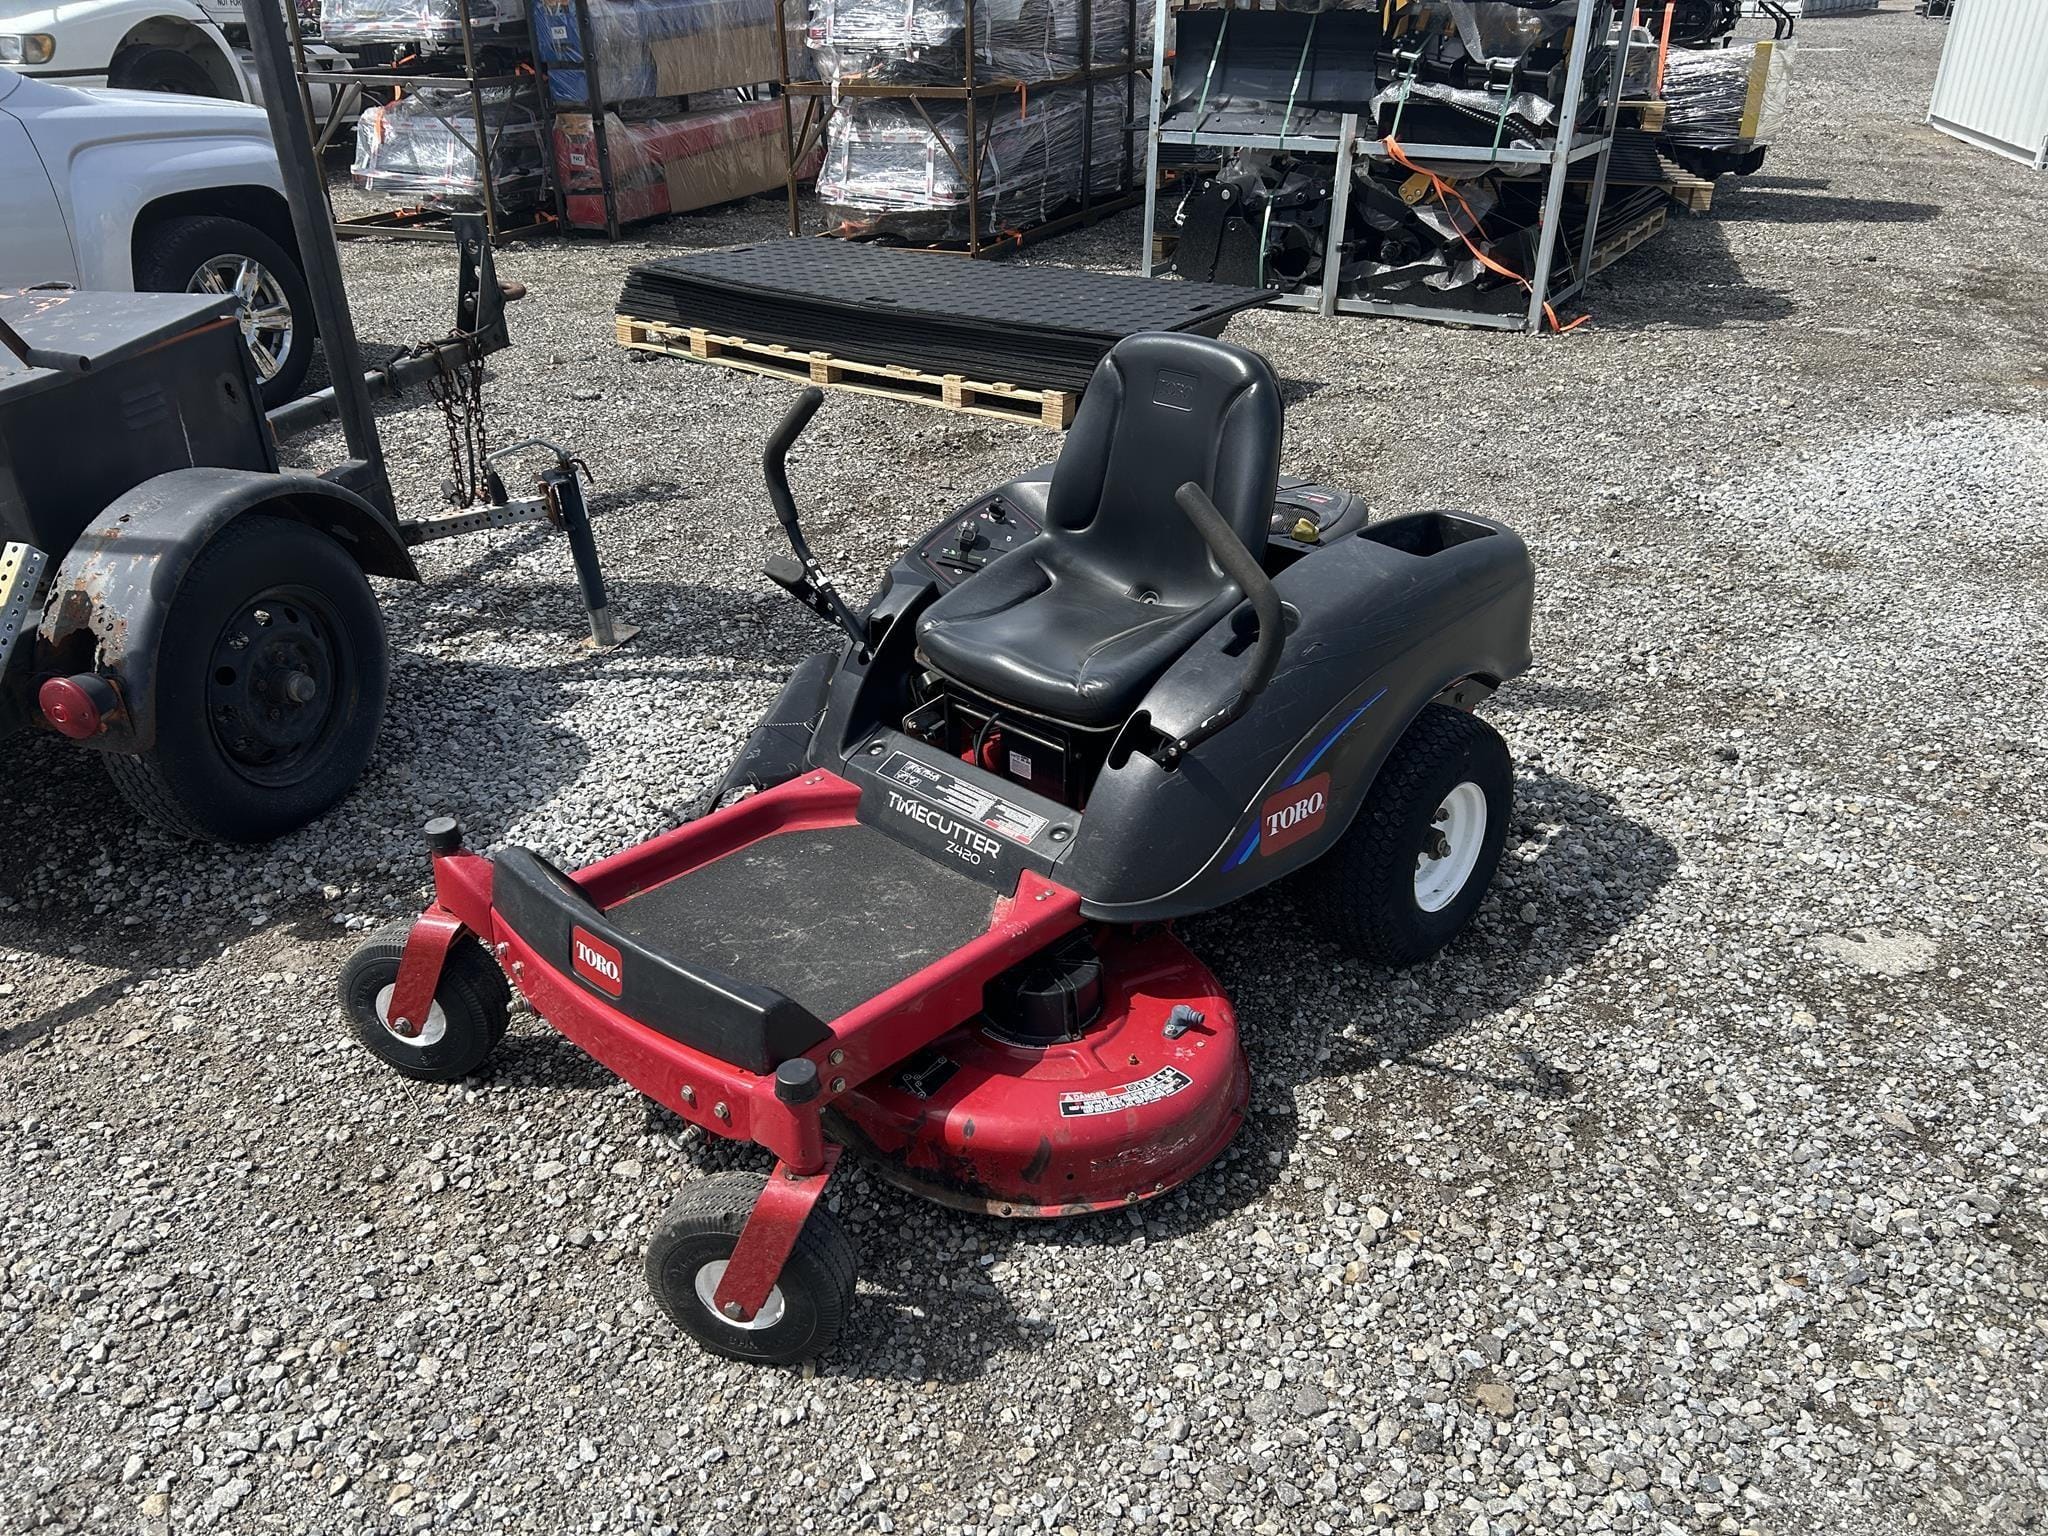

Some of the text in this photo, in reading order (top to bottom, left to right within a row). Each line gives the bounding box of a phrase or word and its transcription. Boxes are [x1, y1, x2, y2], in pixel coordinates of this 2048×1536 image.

[888, 790, 1001, 859] TIMECUTTER
[1266, 792, 1323, 837] TORO
[945, 840, 981, 865] Z420
[576, 940, 619, 980] TORO
